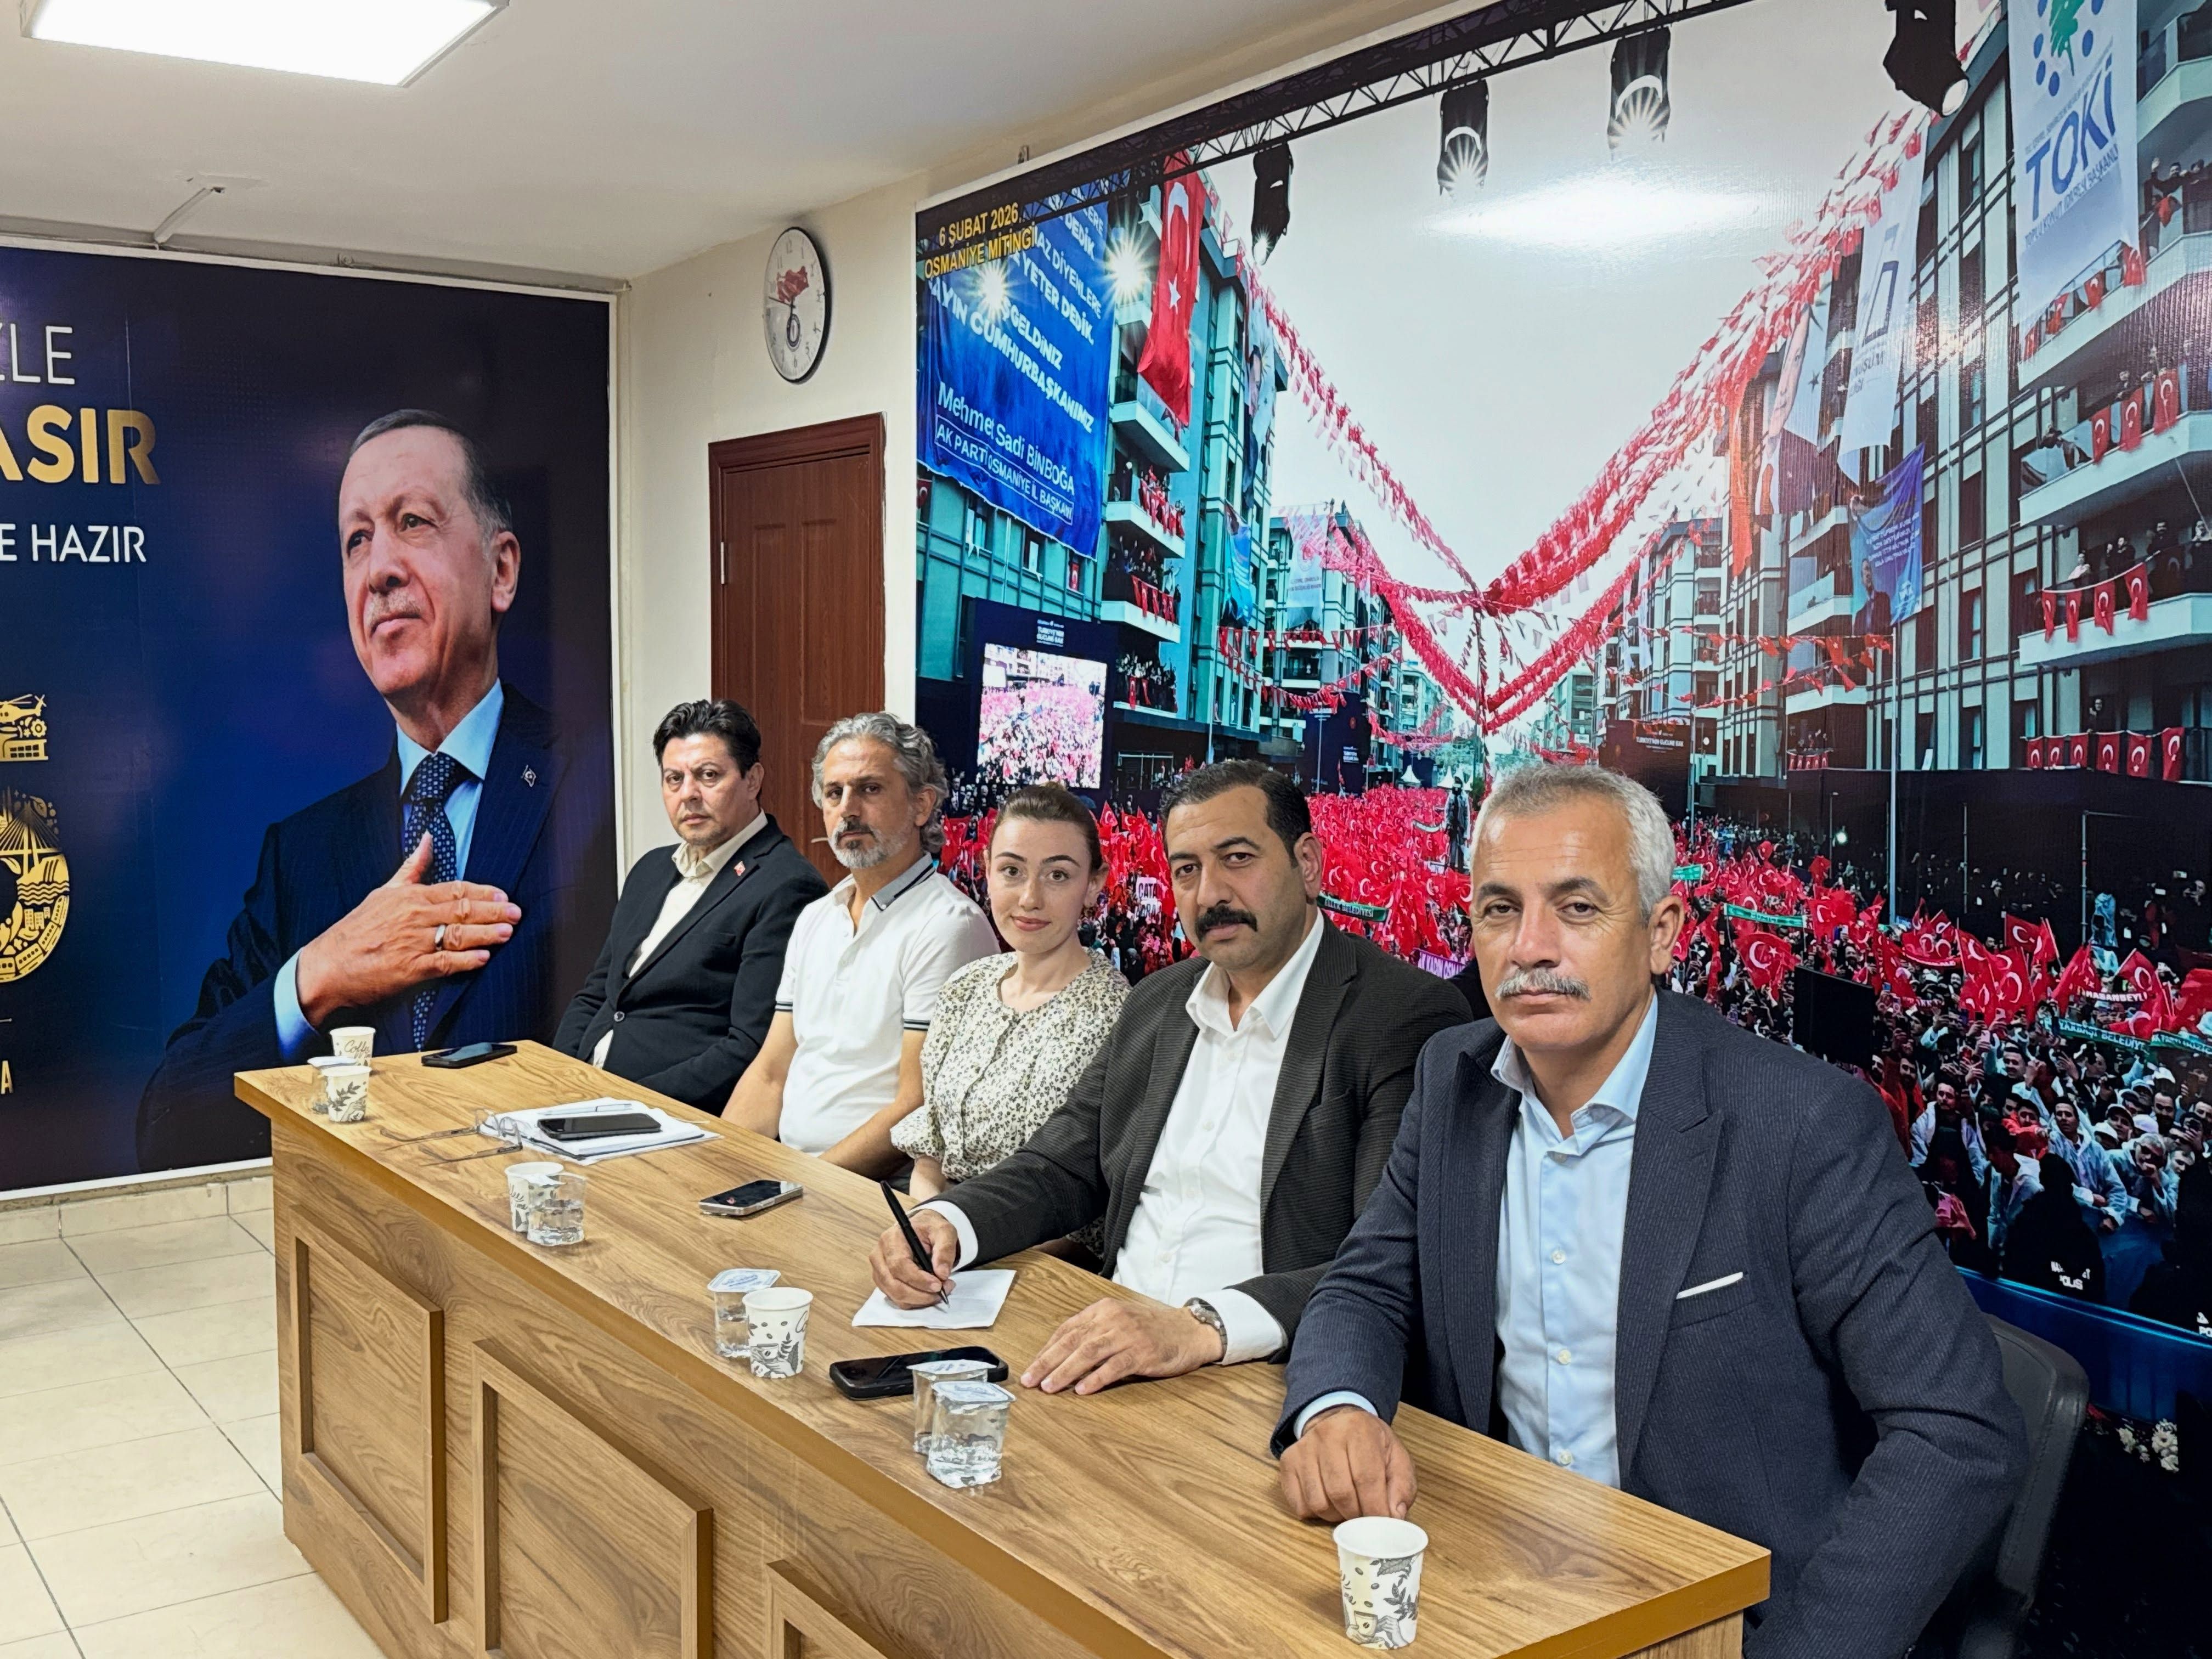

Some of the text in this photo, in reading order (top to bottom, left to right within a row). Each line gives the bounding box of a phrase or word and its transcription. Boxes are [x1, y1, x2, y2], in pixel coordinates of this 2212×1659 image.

[924, 242, 985, 279] OSMANİYE
[988, 221, 1035, 259] MİTİNGİ
[938, 226, 946, 247] 6
[948, 212, 988, 248] ŞUBAT
[928, 277, 968, 326] AYIN
[1022, 250, 1060, 311] YETER
[1052, 248, 1102, 320] DİYENLERE
[936, 424, 954, 447] AK
[954, 433, 988, 466] PARTİ
[988, 454, 1031, 495] OSMANİYE
[995, 423, 1025, 460] Sadi
[1026, 443, 1075, 496] BİNBOĞA
[31, 524, 147, 563] HAZIR
[1, 1060, 14, 1094] A
